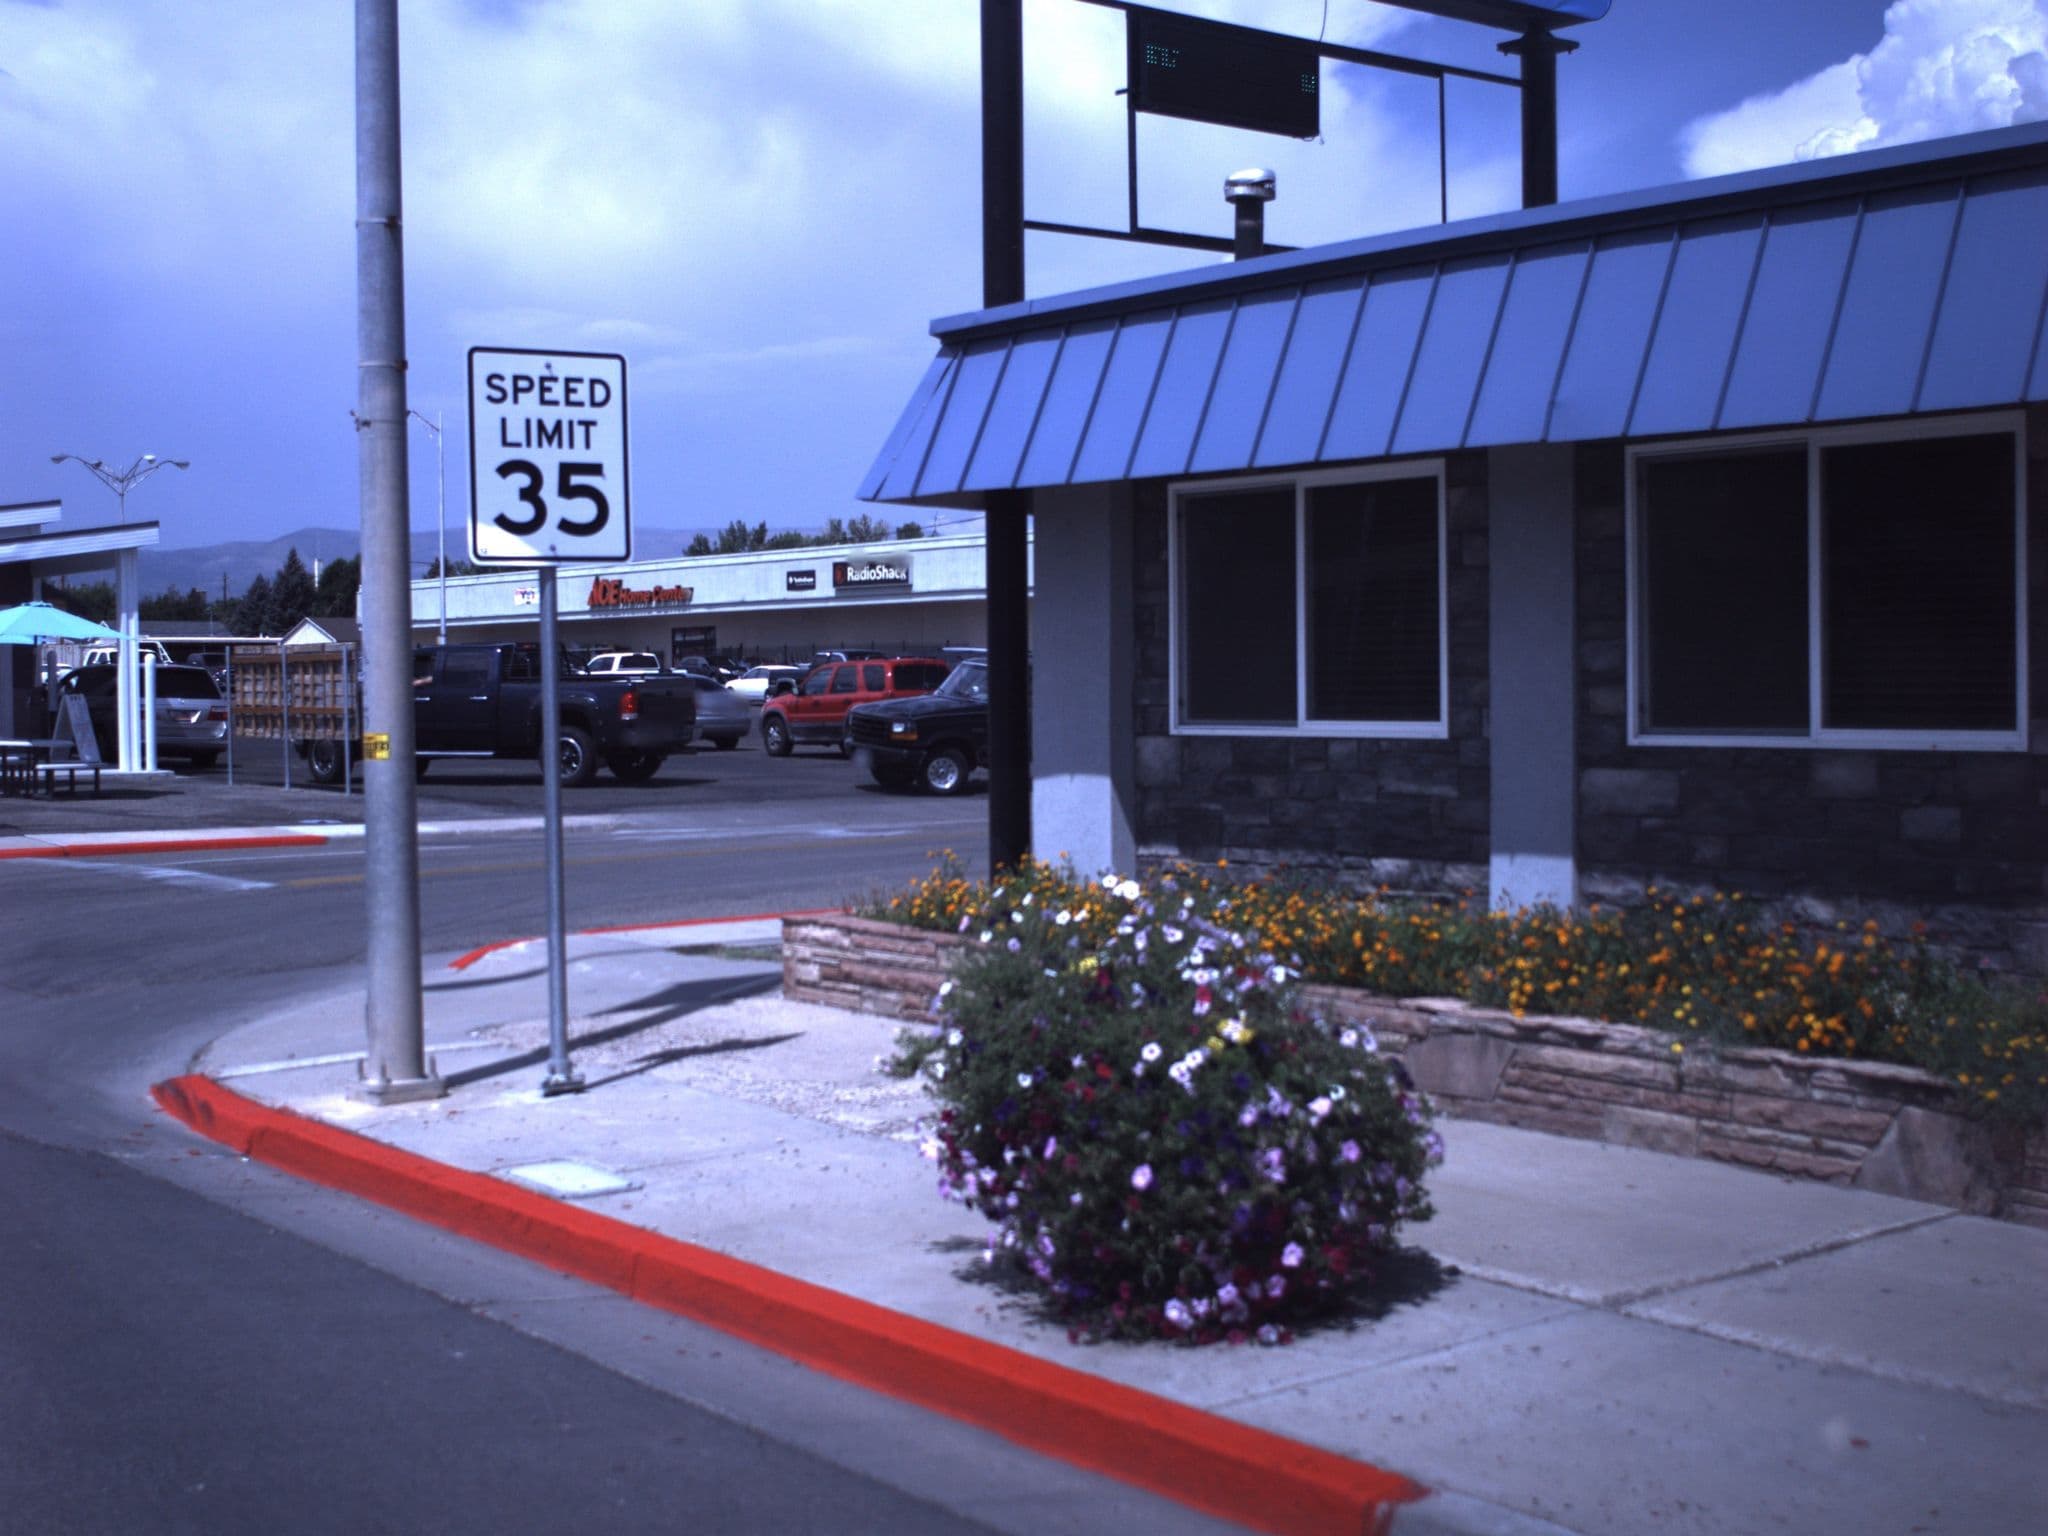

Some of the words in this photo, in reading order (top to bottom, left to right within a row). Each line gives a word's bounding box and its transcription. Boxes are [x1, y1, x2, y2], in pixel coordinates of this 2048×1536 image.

[486, 373, 611, 408] SPEED
[501, 417, 598, 450] LIMIT
[493, 459, 610, 537] 35
[847, 564, 907, 582] RadioShack
[588, 575, 622, 606] ACE
[621, 588, 653, 604] Home
